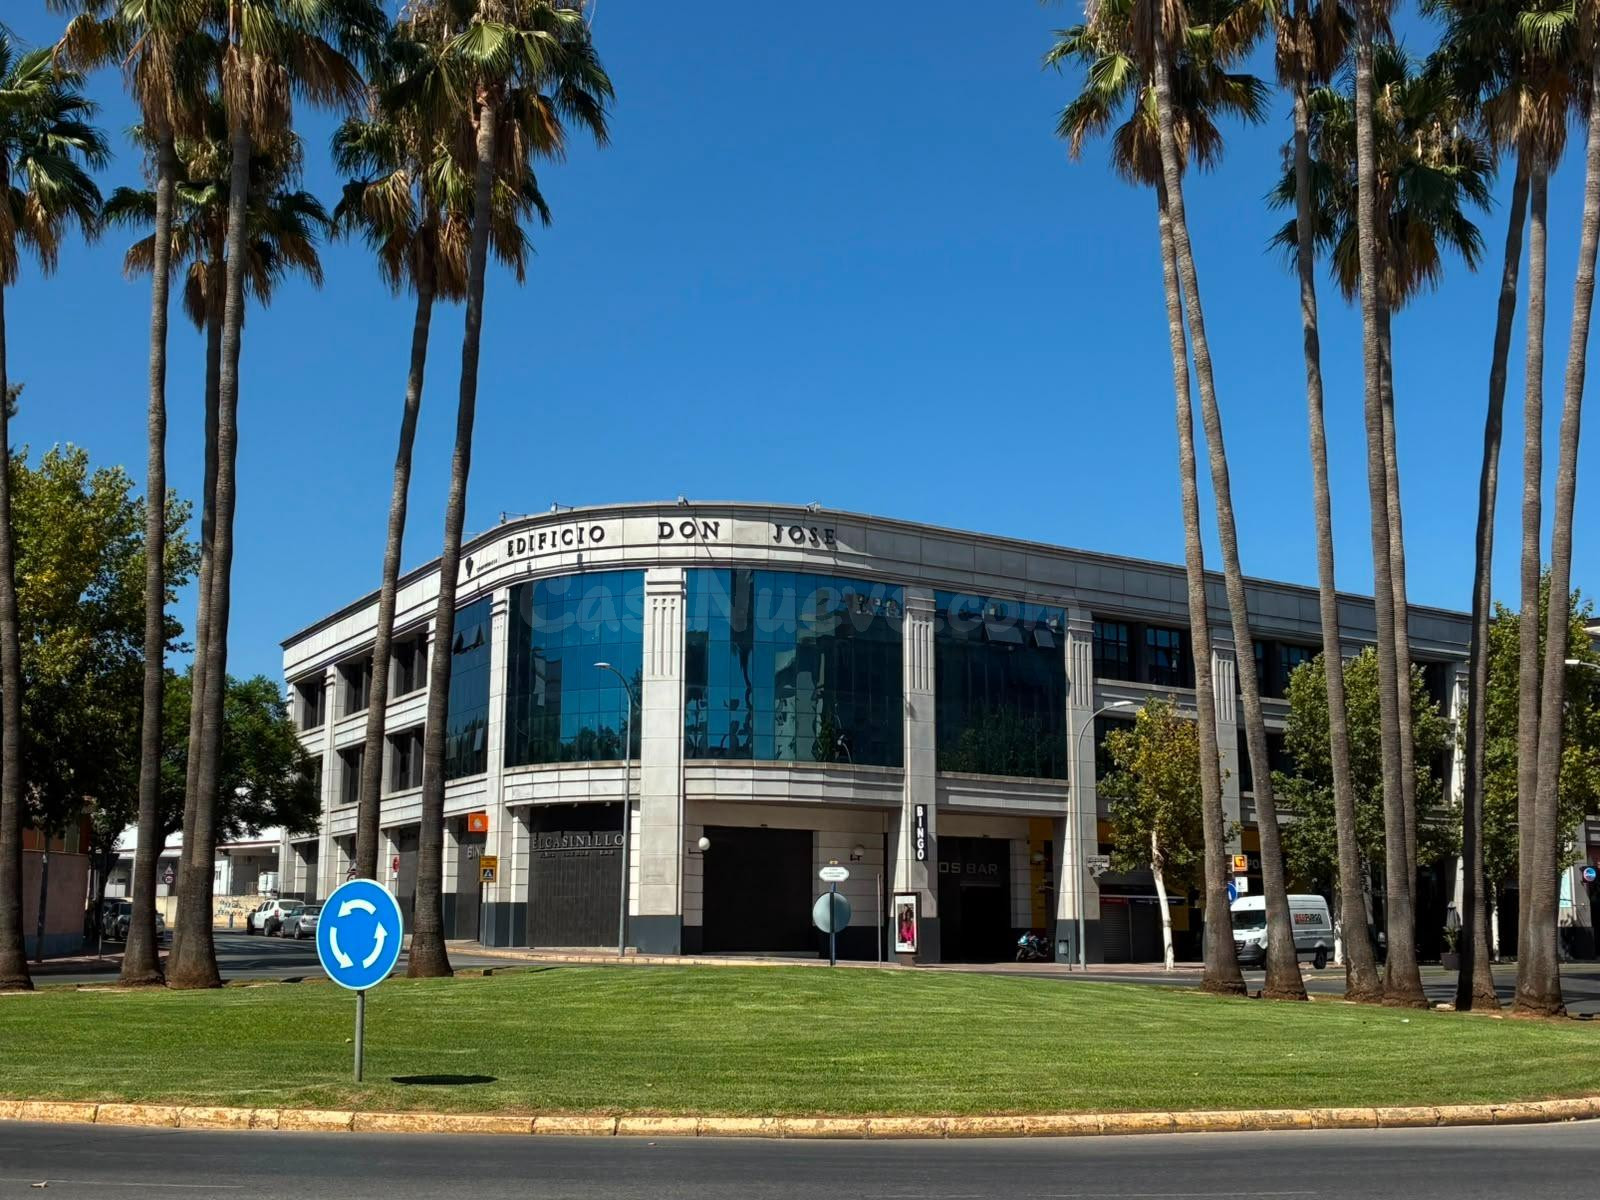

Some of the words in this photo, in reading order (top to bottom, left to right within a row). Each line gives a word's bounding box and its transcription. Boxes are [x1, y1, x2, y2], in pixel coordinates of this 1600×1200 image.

[507, 525, 605, 558] EDIFICIO
[658, 521, 720, 541] DON
[772, 524, 836, 547] JOSE
[916, 805, 925, 860] BINGO
